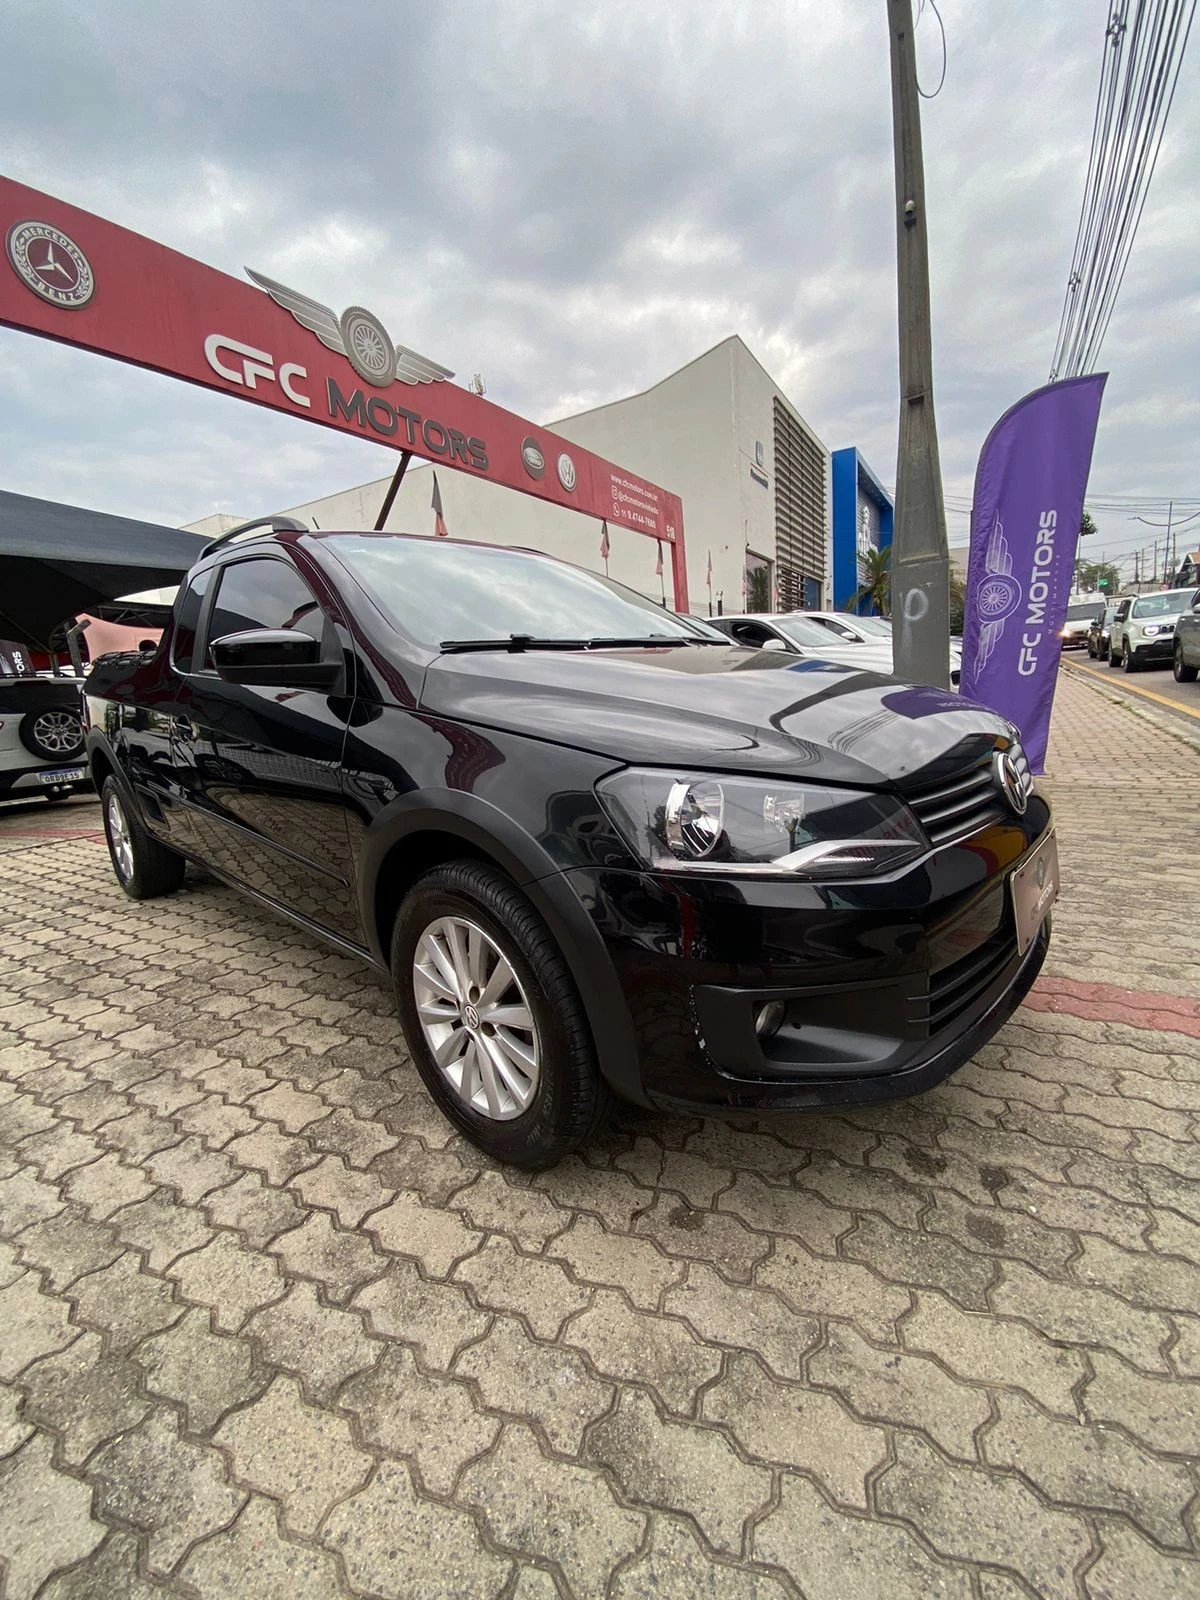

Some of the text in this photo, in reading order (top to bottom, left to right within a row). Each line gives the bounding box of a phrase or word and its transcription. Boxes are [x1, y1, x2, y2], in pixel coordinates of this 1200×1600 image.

[21, 227, 80, 259] MERCEDES
[38, 281, 76, 301] BENZ
[204, 333, 488, 471] CFC MOTORS
[1017, 509, 1058, 676] CFC MOTORS
